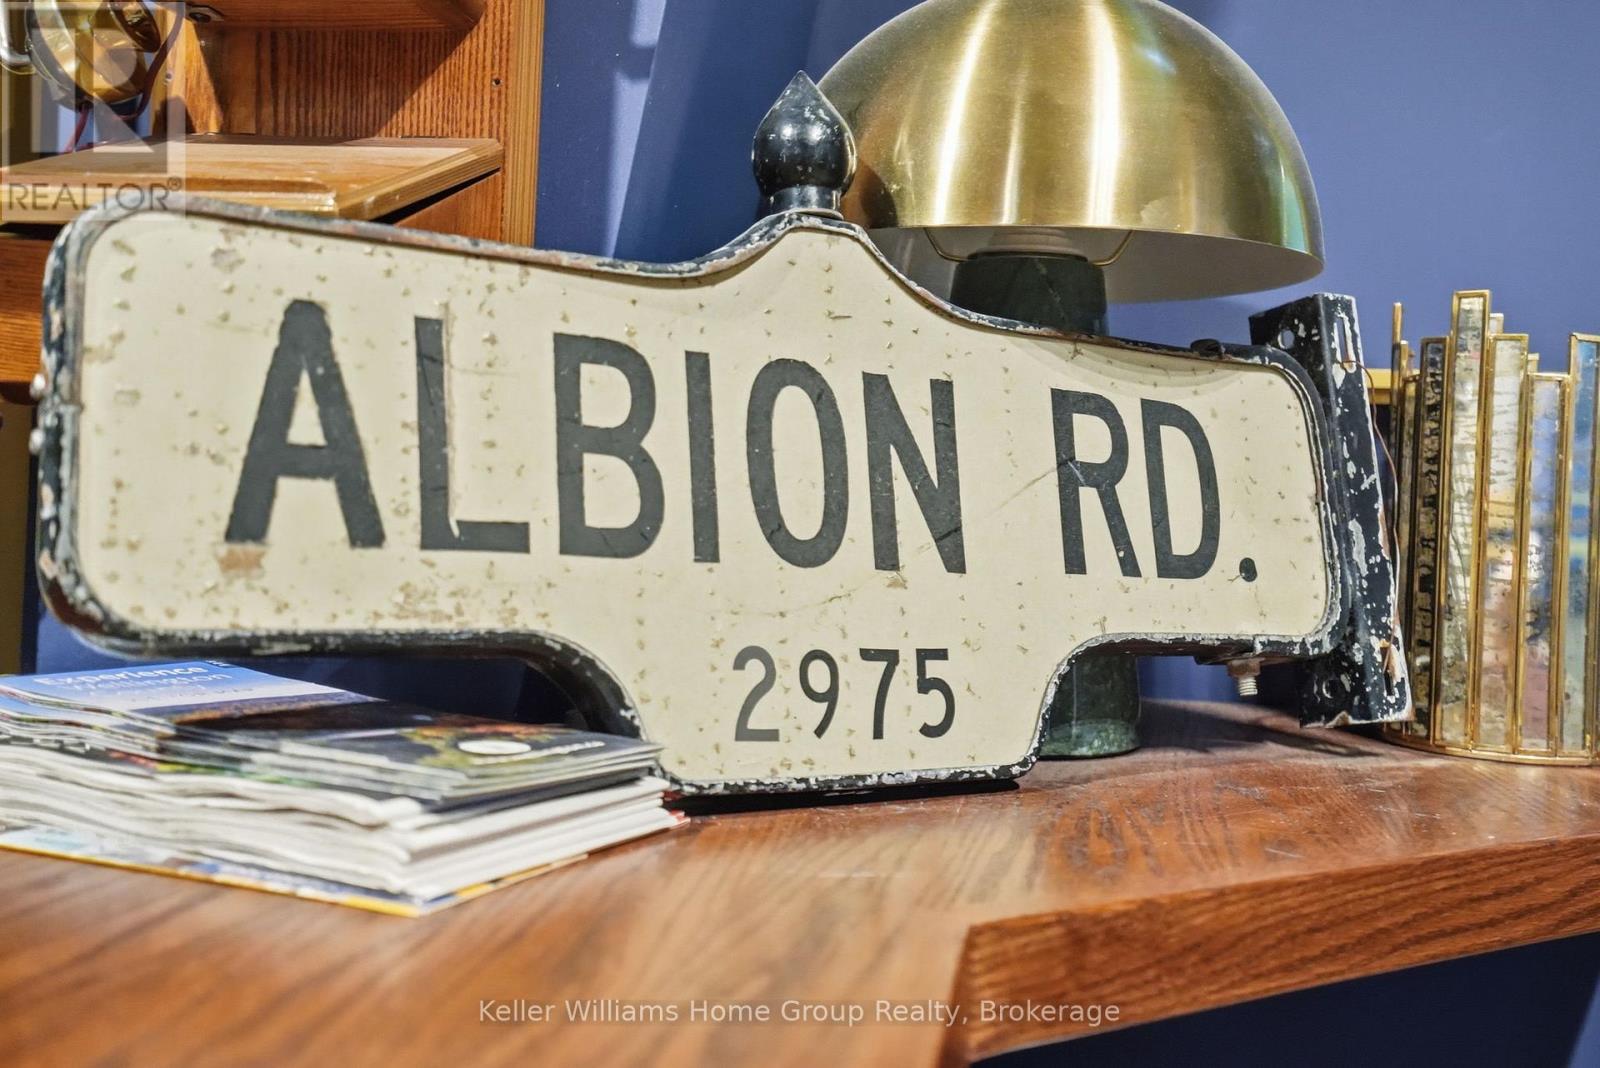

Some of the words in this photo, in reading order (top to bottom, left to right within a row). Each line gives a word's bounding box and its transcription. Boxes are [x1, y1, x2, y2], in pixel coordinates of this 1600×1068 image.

[225, 299, 966, 574] ALBION
[1051, 388, 1257, 582] RD.
[33, 666, 208, 685] Experience
[734, 645, 956, 742] 2975
